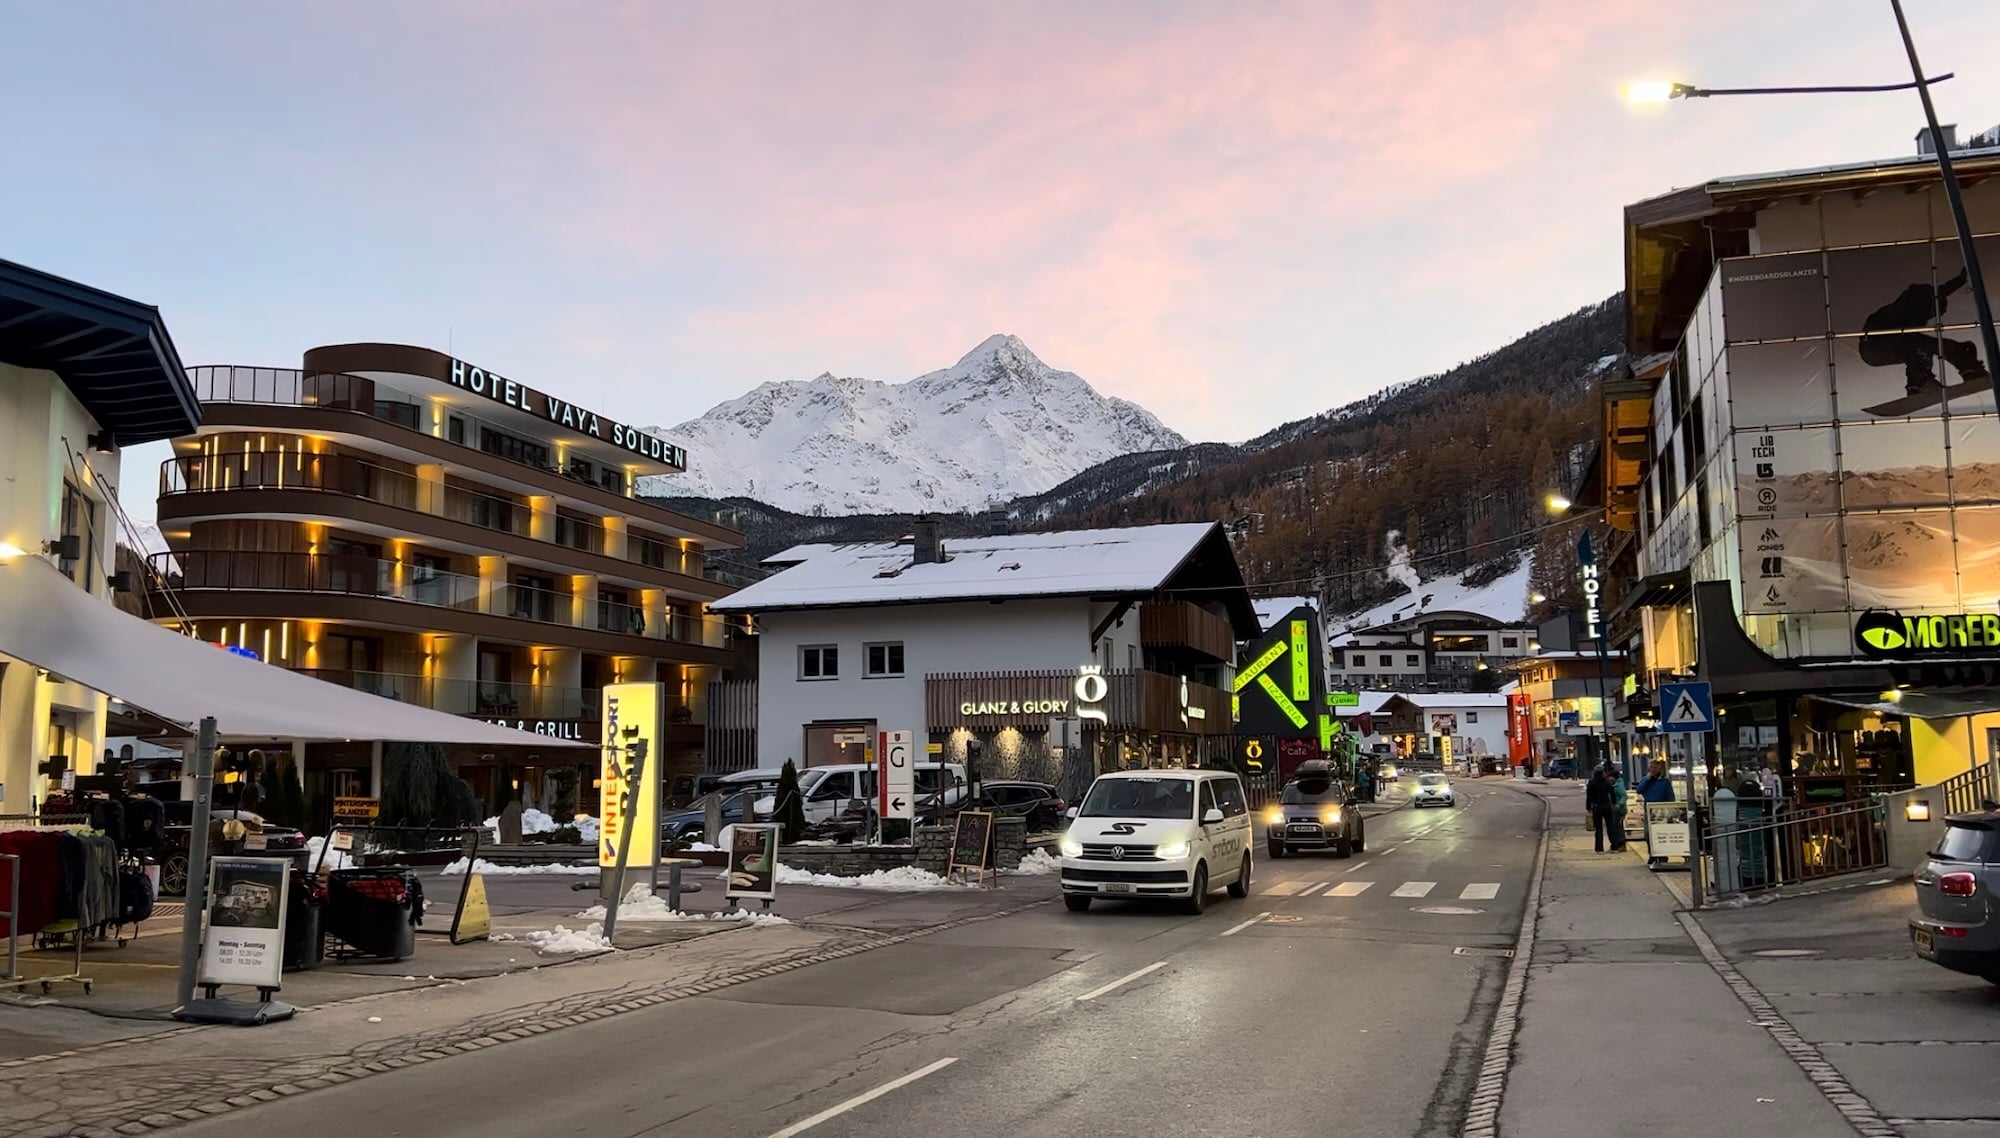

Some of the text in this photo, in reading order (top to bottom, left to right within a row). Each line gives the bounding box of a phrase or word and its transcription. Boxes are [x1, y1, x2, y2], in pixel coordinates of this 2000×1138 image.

[451, 358, 684, 468] HOTEL VAYA SÖLDEN
[1760, 435, 1774, 446] LIB
[1752, 447, 1775, 458] TECH
[1583, 565, 1602, 639] HOTEL
[960, 700, 1069, 715] GLANZ & GLORY
[1262, 678, 1302, 724] PIZZERIA
[535, 721, 582, 739] GRILL
[605, 696, 619, 834] INTERSPORT
[890, 746, 905, 768] G
[1212, 838, 1241, 860] STÖCKLI
[243, 942, 266, 950] Sonntag
